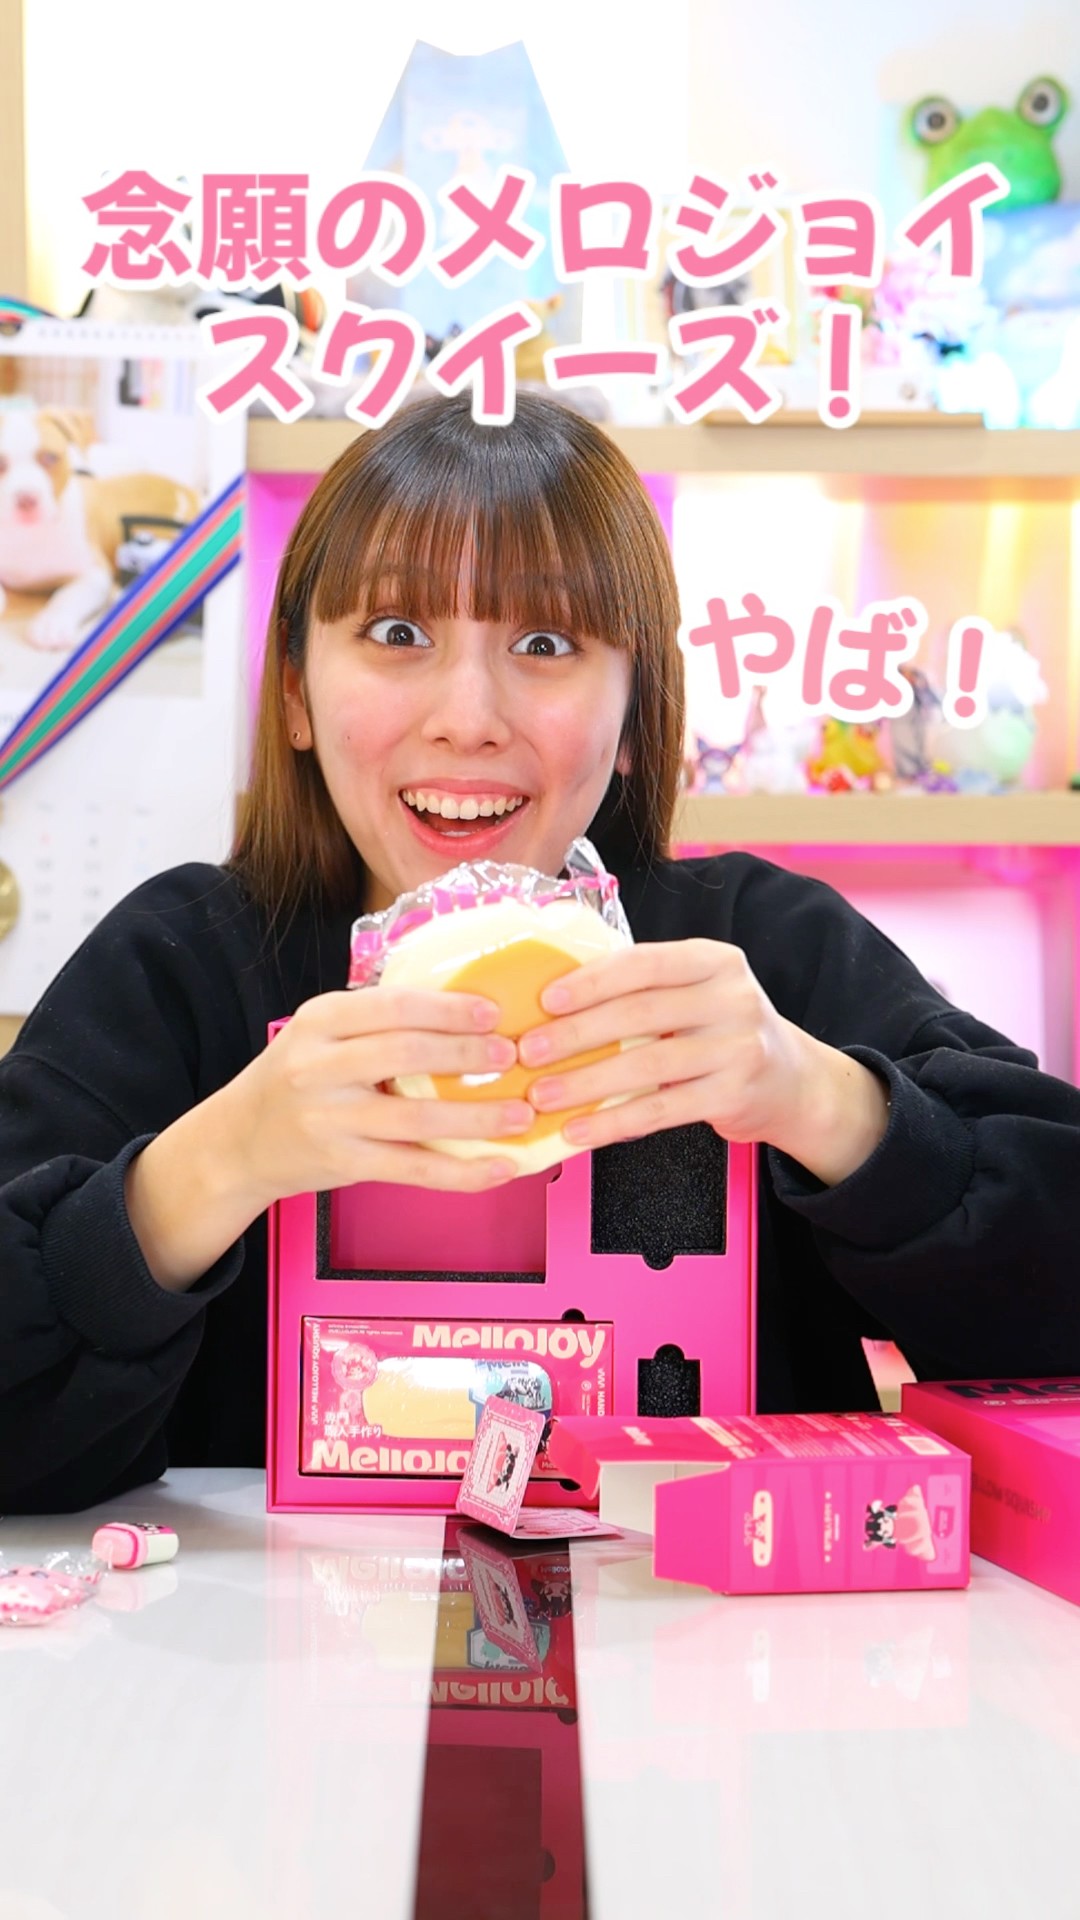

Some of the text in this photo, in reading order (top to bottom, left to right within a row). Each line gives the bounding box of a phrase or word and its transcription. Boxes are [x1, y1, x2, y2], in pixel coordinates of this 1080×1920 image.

[311, 1323, 321, 1403] MELLOJOY SQUISHY
[311, 1439, 470, 1472] MelloJo
